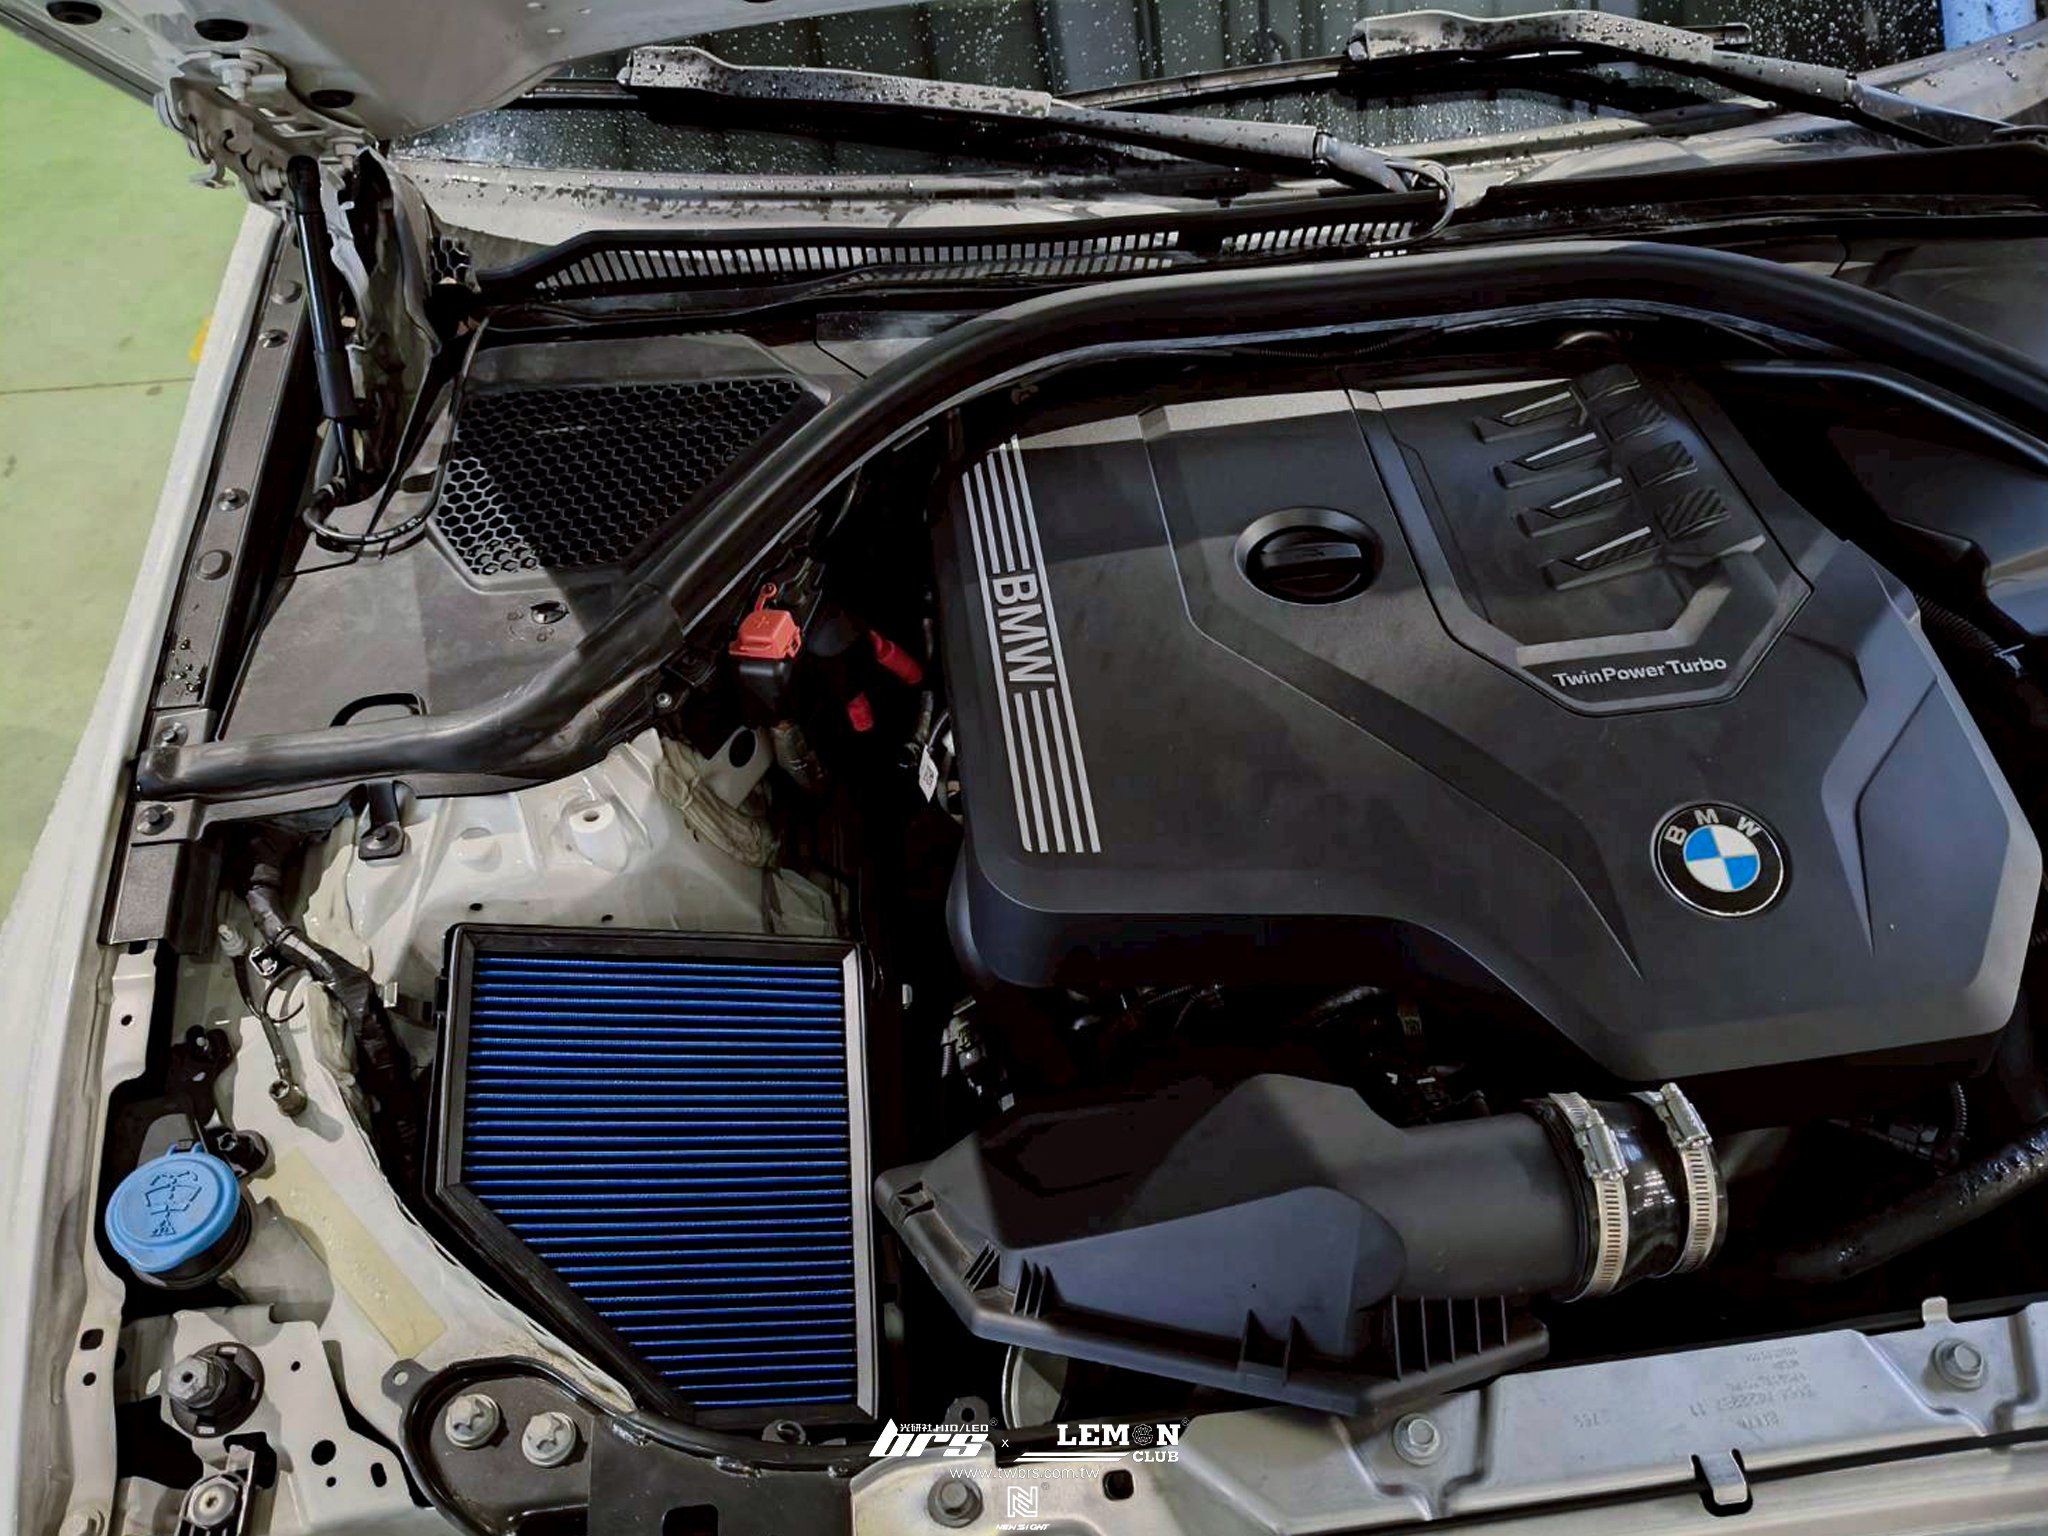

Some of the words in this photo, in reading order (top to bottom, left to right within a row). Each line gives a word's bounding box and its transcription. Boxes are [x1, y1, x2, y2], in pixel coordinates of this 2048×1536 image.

[992, 573, 1056, 682] BMW
[1552, 664, 1666, 687] TwinPower
[1666, 656, 1728, 675] Turbo
[1663, 808, 1762, 846] BMW
